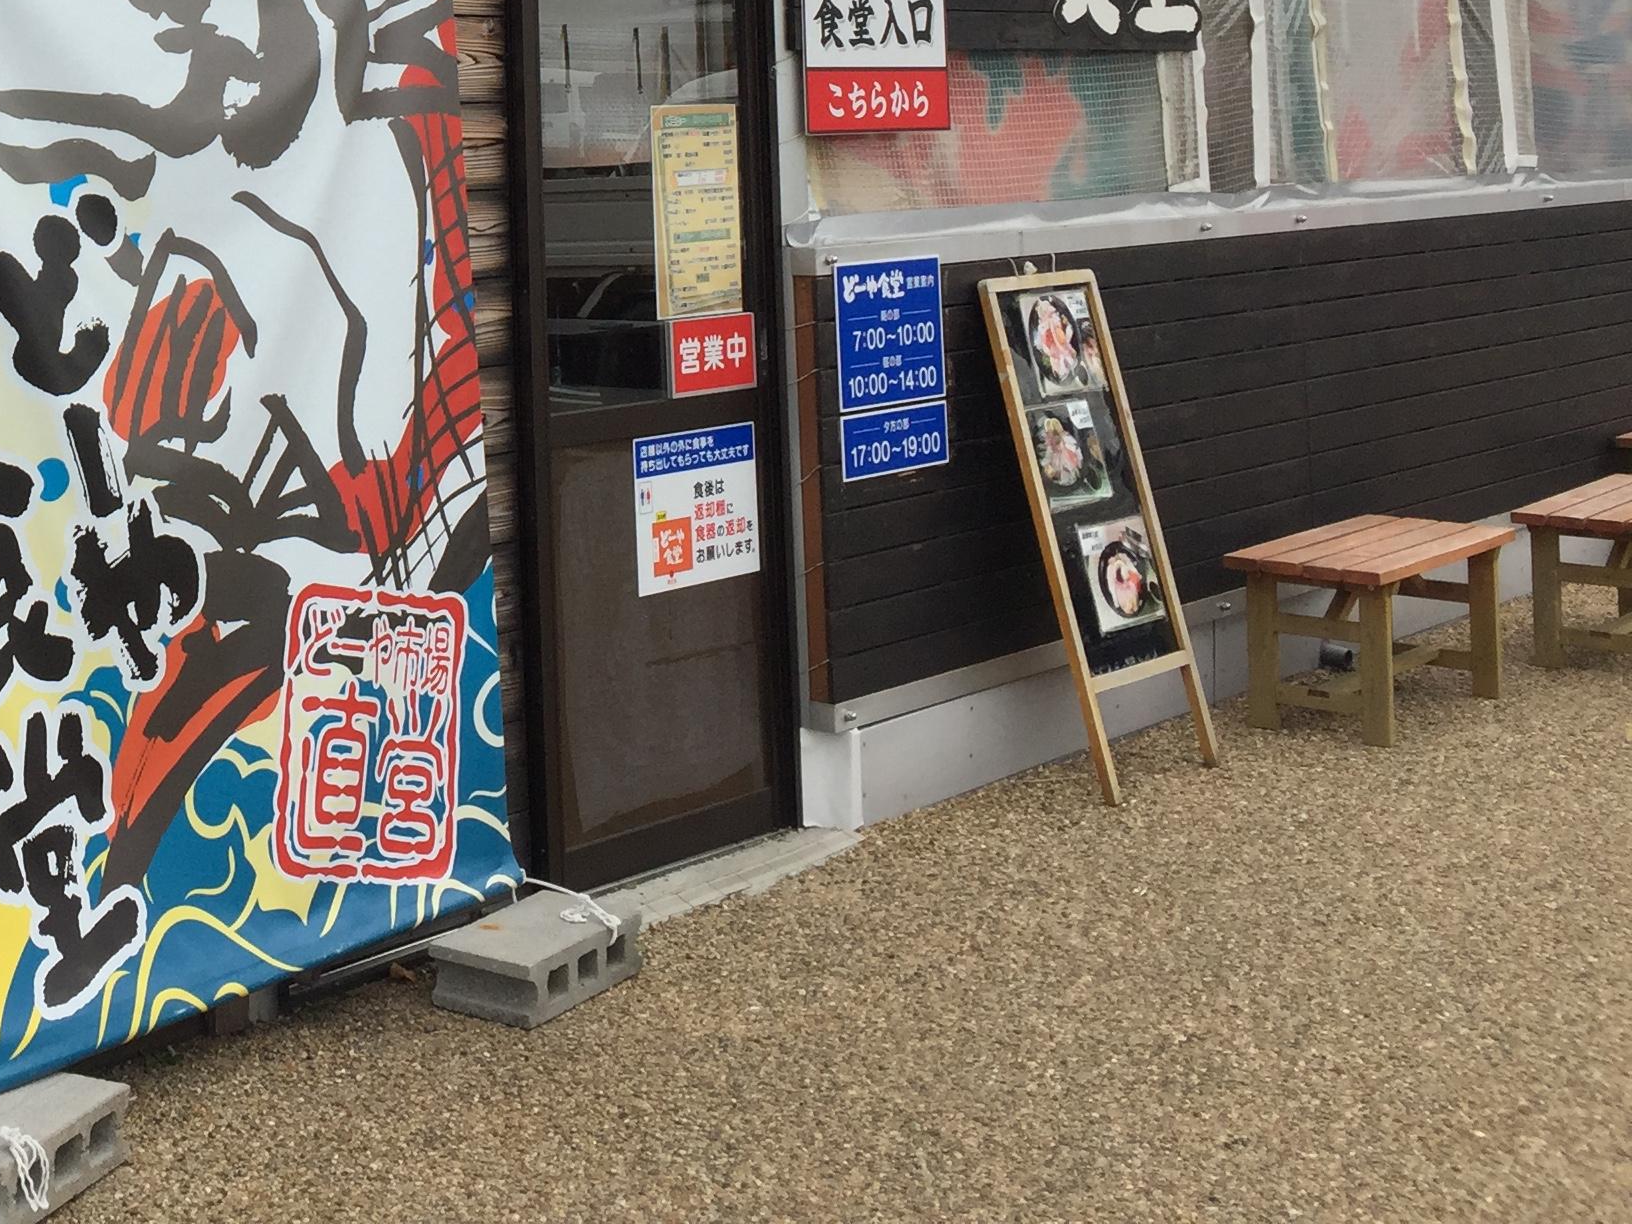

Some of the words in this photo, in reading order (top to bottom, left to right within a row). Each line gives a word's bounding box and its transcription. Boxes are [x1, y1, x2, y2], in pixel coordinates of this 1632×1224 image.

[828, 80, 930, 119] こちらから
[678, 332, 747, 376] 営業中
[693, 478, 725, 499] 食後は
[304, 608, 451, 695] どーや市場
[297, 680, 444, 855] 直営
